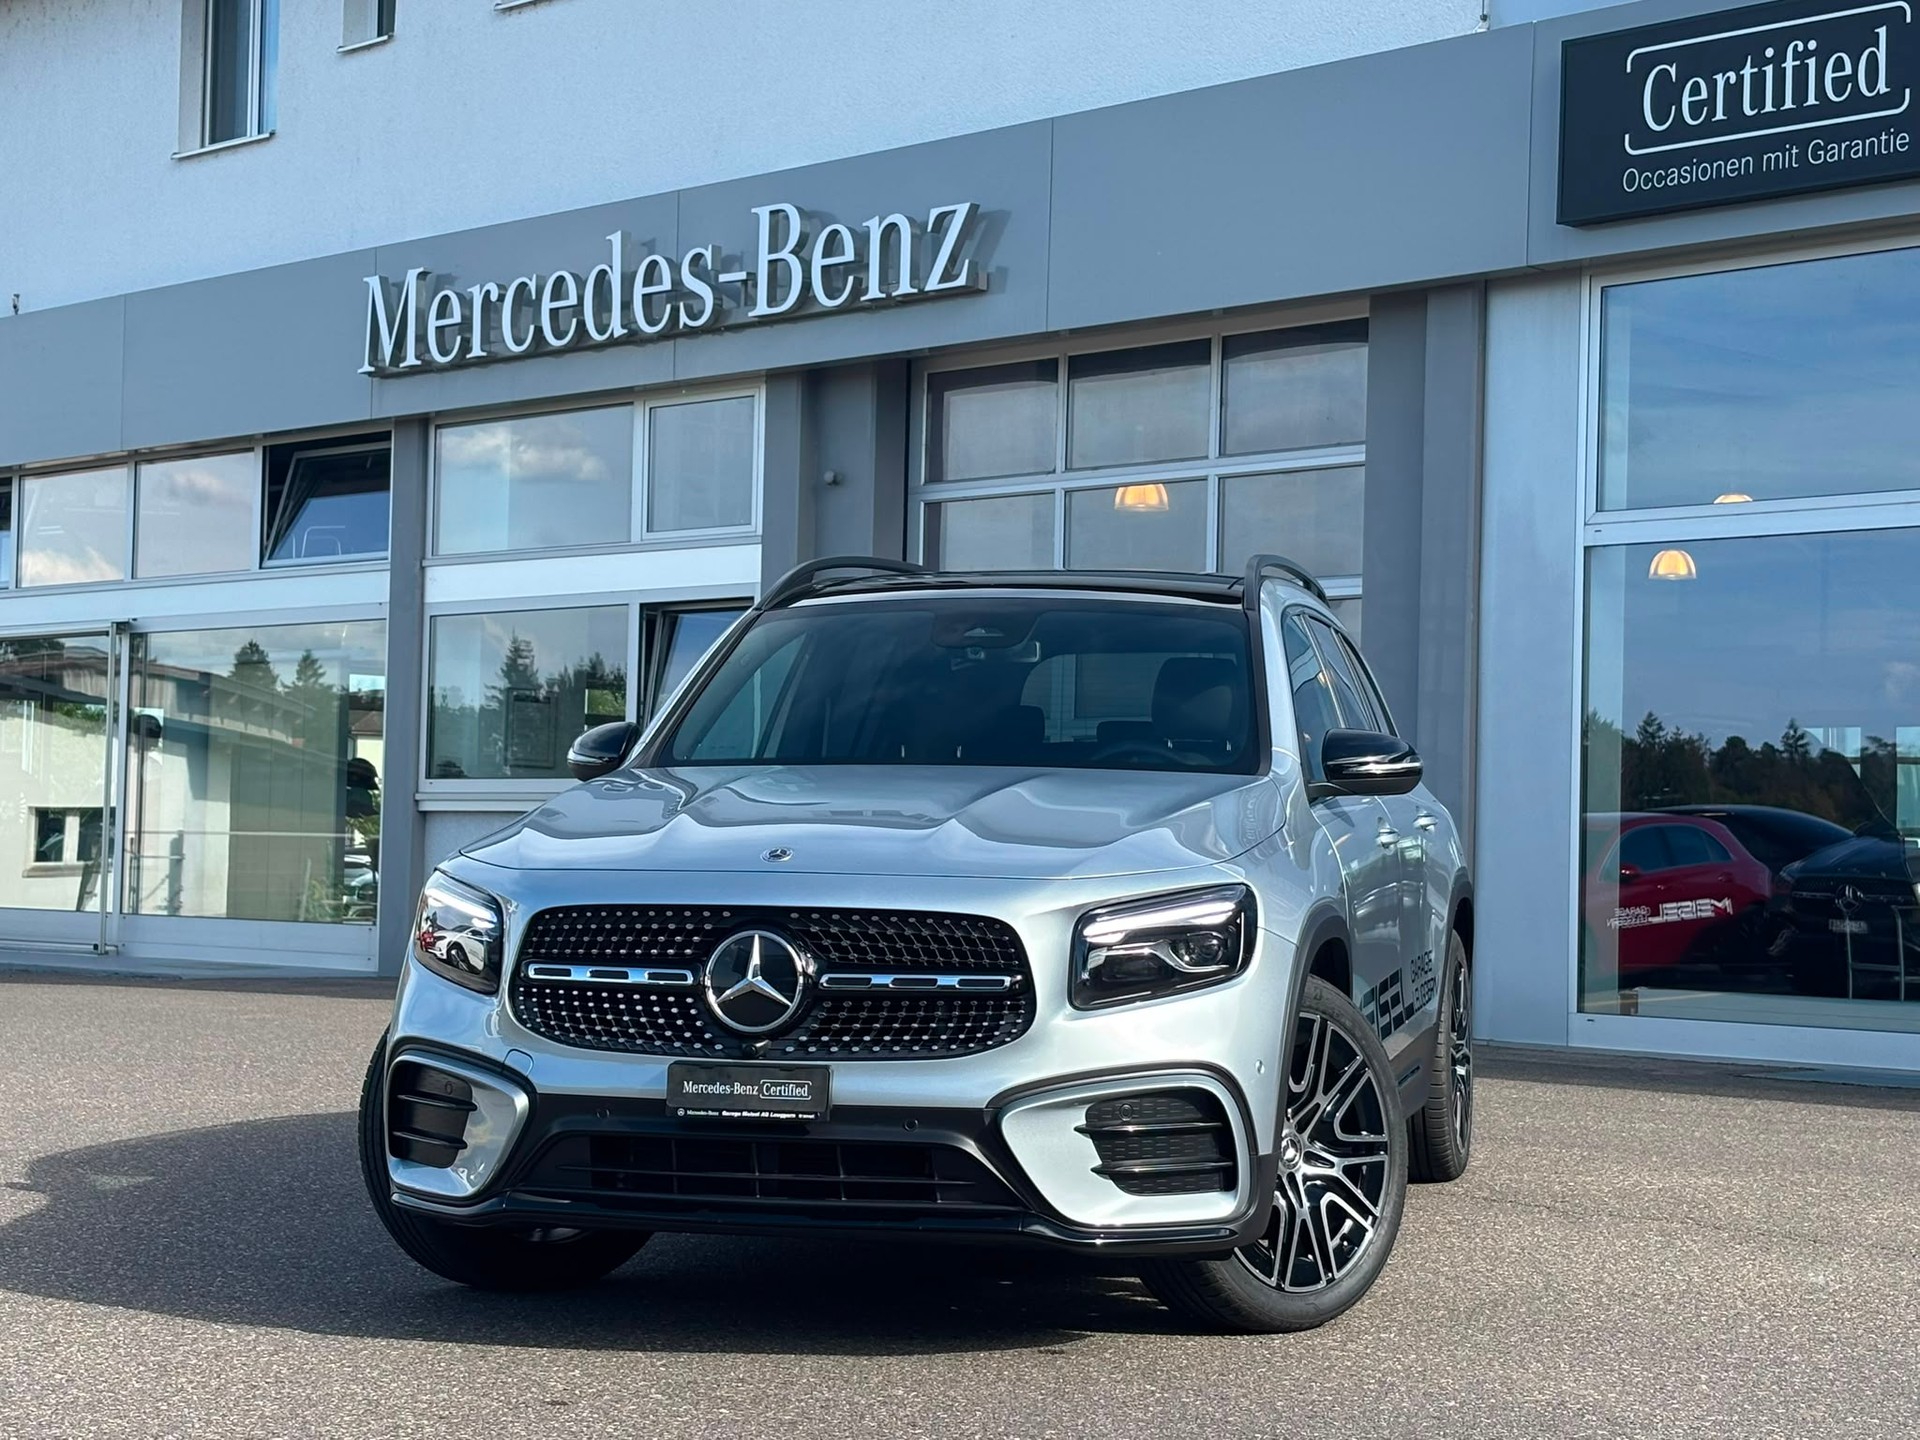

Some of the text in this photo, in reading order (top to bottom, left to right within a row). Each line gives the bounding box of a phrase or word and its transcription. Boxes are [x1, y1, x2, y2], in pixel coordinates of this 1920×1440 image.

[1643, 25, 1891, 132] Certified
[1622, 128, 1910, 193] Occasionen mit Garantie
[357, 201, 981, 374] Mercedes-Benz
[682, 1080, 809, 1097] Mercedes-Benz Certified
